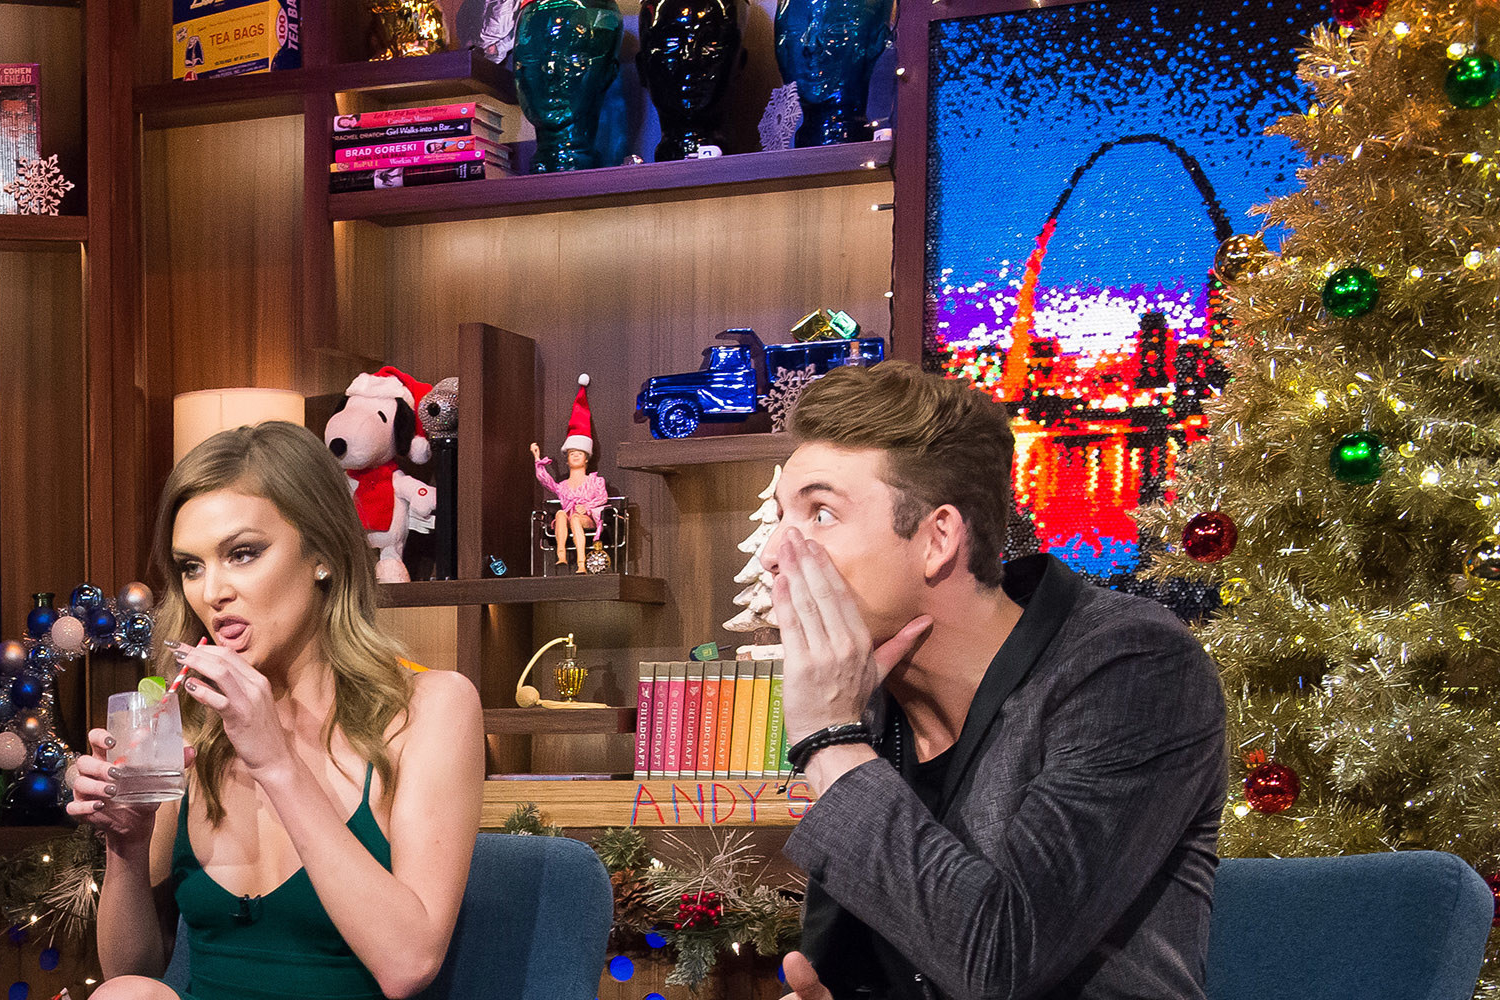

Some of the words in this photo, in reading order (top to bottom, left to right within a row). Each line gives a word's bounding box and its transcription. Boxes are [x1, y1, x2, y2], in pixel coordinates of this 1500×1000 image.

[209, 31, 230, 46] TEA
[233, 23, 265, 41] BAGS
[278, 15, 286, 40] 100
[287, 23, 299, 51] TEA
[3, 67, 32, 75] COHEN
[345, 148, 372, 158] BRAD
[374, 143, 418, 155] GORESKI
[386, 126, 399, 136] Girl
[400, 125, 419, 135] Walks
[420, 124, 433, 133] into
[637, 701, 648, 767] CHILDCRAFT
[653, 701, 664, 767] CHILDCRAFT
[668, 701, 679, 767] CHILDCRAFT
[685, 701, 696, 767] CHILDCRAFT
[702, 700, 713, 767] CHILDCRAFT
[718, 700, 729, 766] CHILDCRAFT
[768, 699, 781, 767] CHILDCRAFT
[630, 781, 813, 825] ANDY'S
